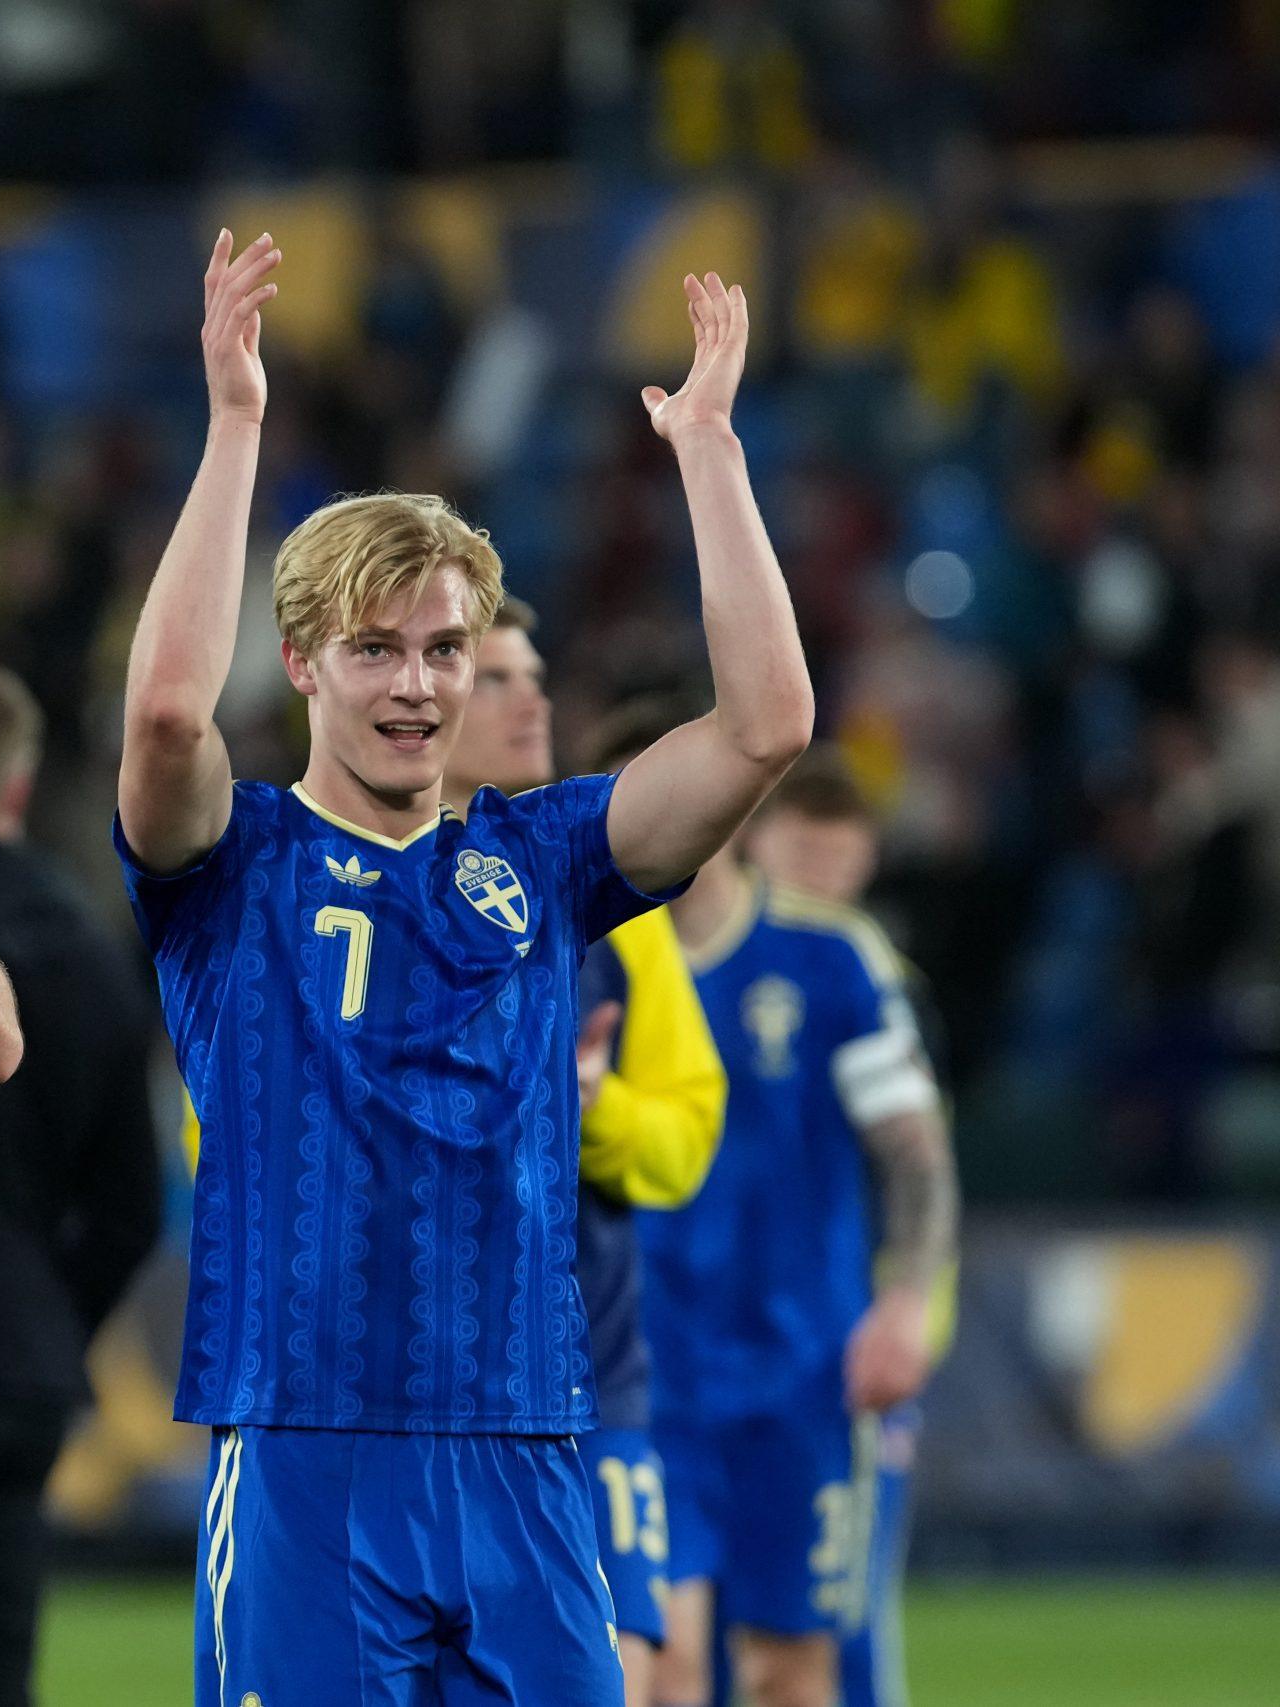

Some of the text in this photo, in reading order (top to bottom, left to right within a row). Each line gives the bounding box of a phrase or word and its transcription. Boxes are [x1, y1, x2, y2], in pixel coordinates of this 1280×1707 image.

[465, 867, 502, 888] SVERIGE
[314, 905, 374, 1020] 7
[597, 1456, 668, 1562] 13
